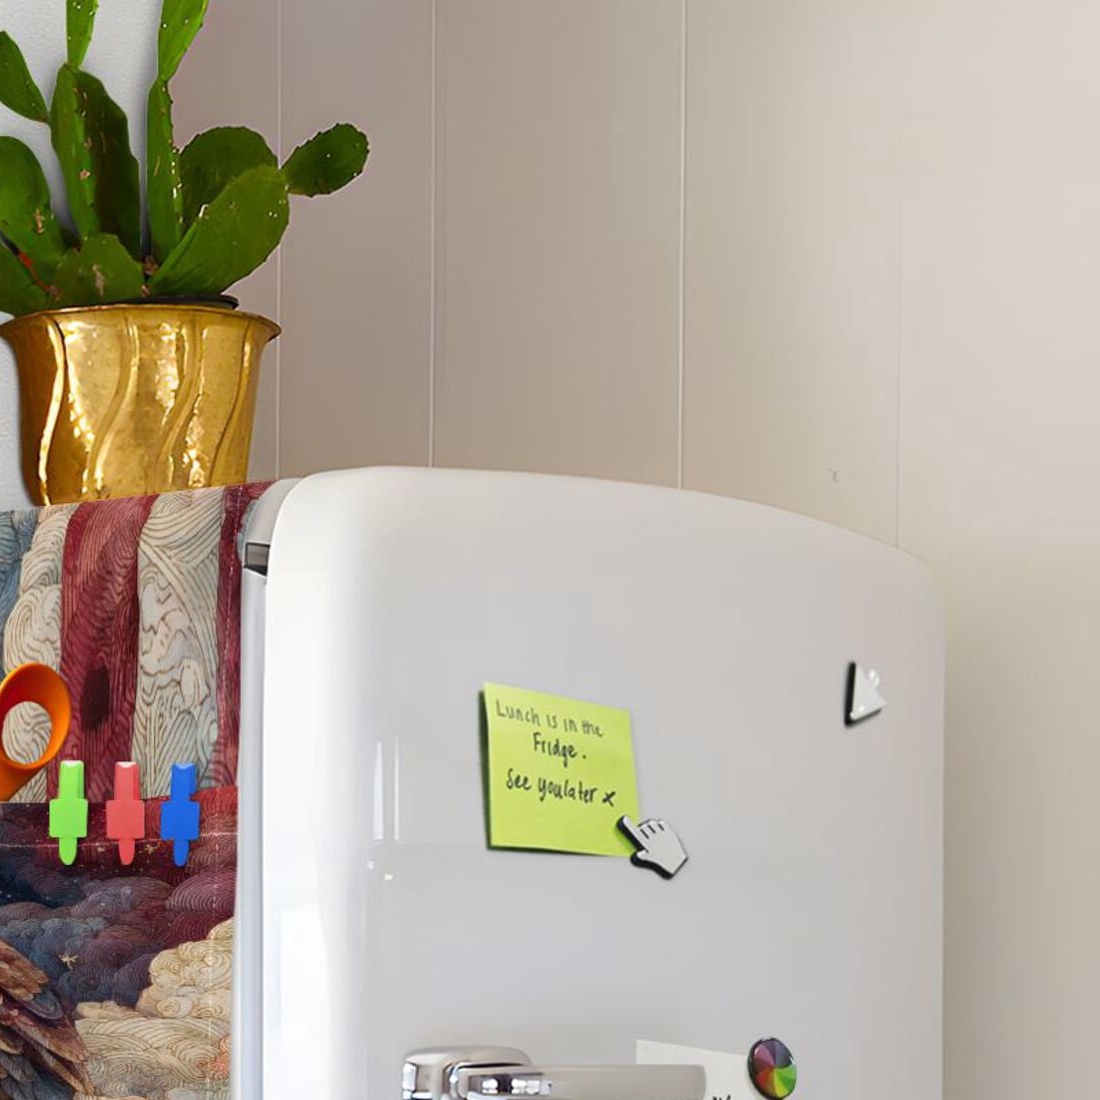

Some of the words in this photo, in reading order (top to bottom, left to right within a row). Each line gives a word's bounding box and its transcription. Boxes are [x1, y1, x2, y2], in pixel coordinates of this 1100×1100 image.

[496, 699, 540, 727] Lunch
[547, 714, 558, 729] is
[564, 717, 578, 733] in
[582, 720, 604, 738] the
[506, 768, 532, 790] See
